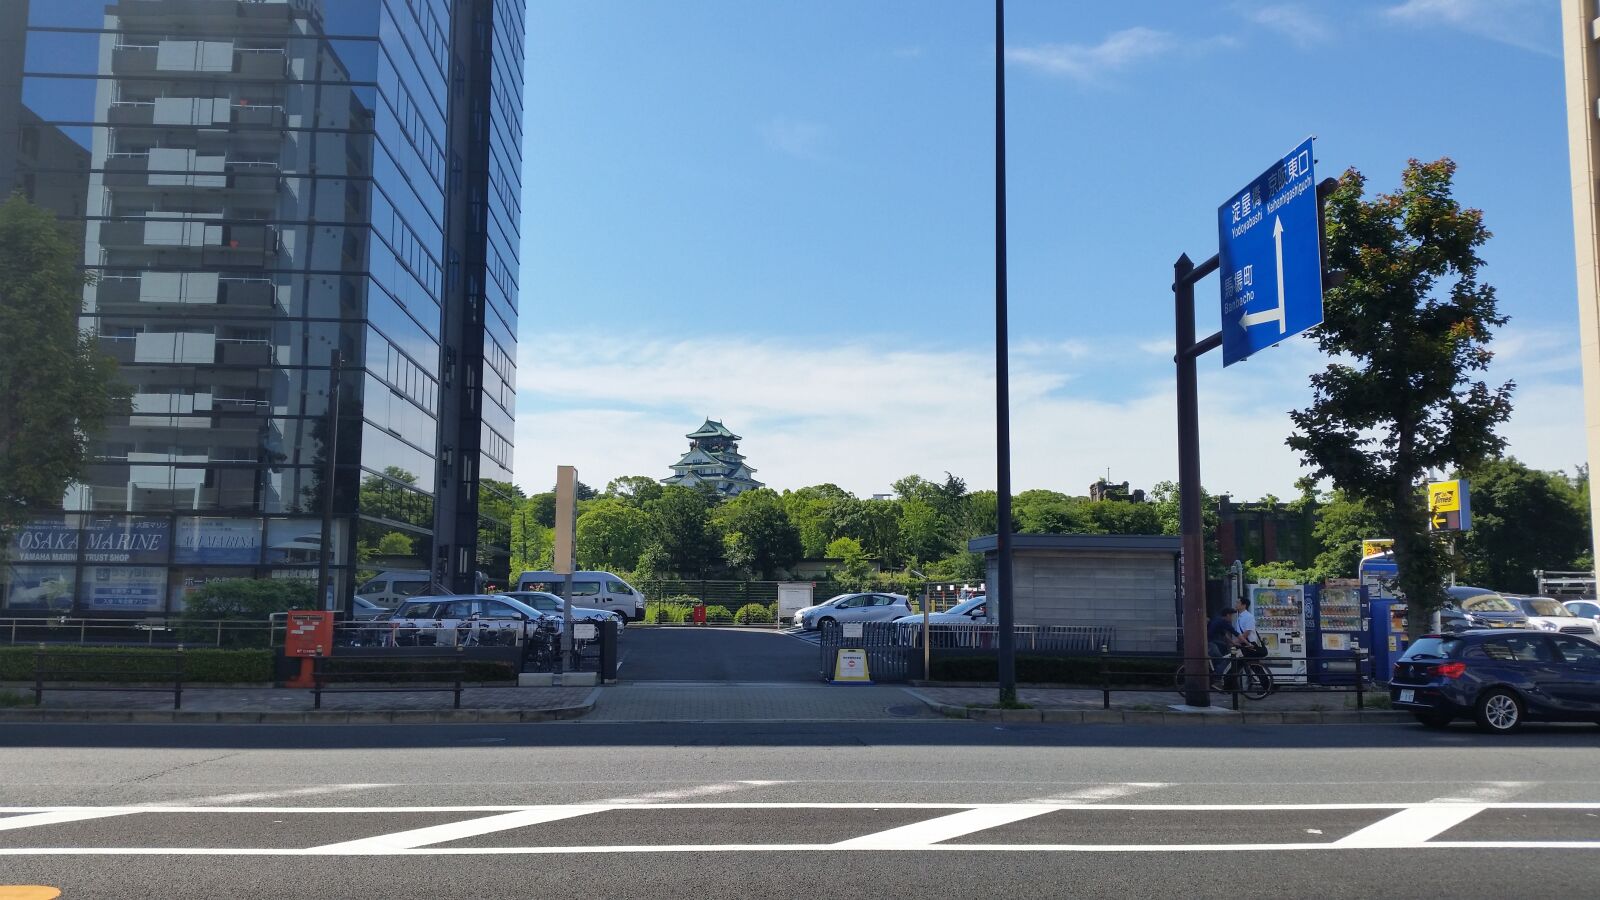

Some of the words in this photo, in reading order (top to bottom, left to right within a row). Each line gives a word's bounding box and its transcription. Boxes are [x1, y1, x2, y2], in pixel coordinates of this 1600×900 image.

[1231, 184, 1262, 224] 淀屋橋
[1267, 149, 1309, 199] 京阪東口
[1231, 208, 1263, 240] Yodoyabashi
[1224, 264, 1253, 299] 馬場町
[19, 531, 79, 550] OSAKA
[86, 532, 163, 550] MARINE
[19, 552, 50, 561] YAMAHA
[84, 553, 109, 561] TRUST
[109, 553, 130, 561] SHOP
